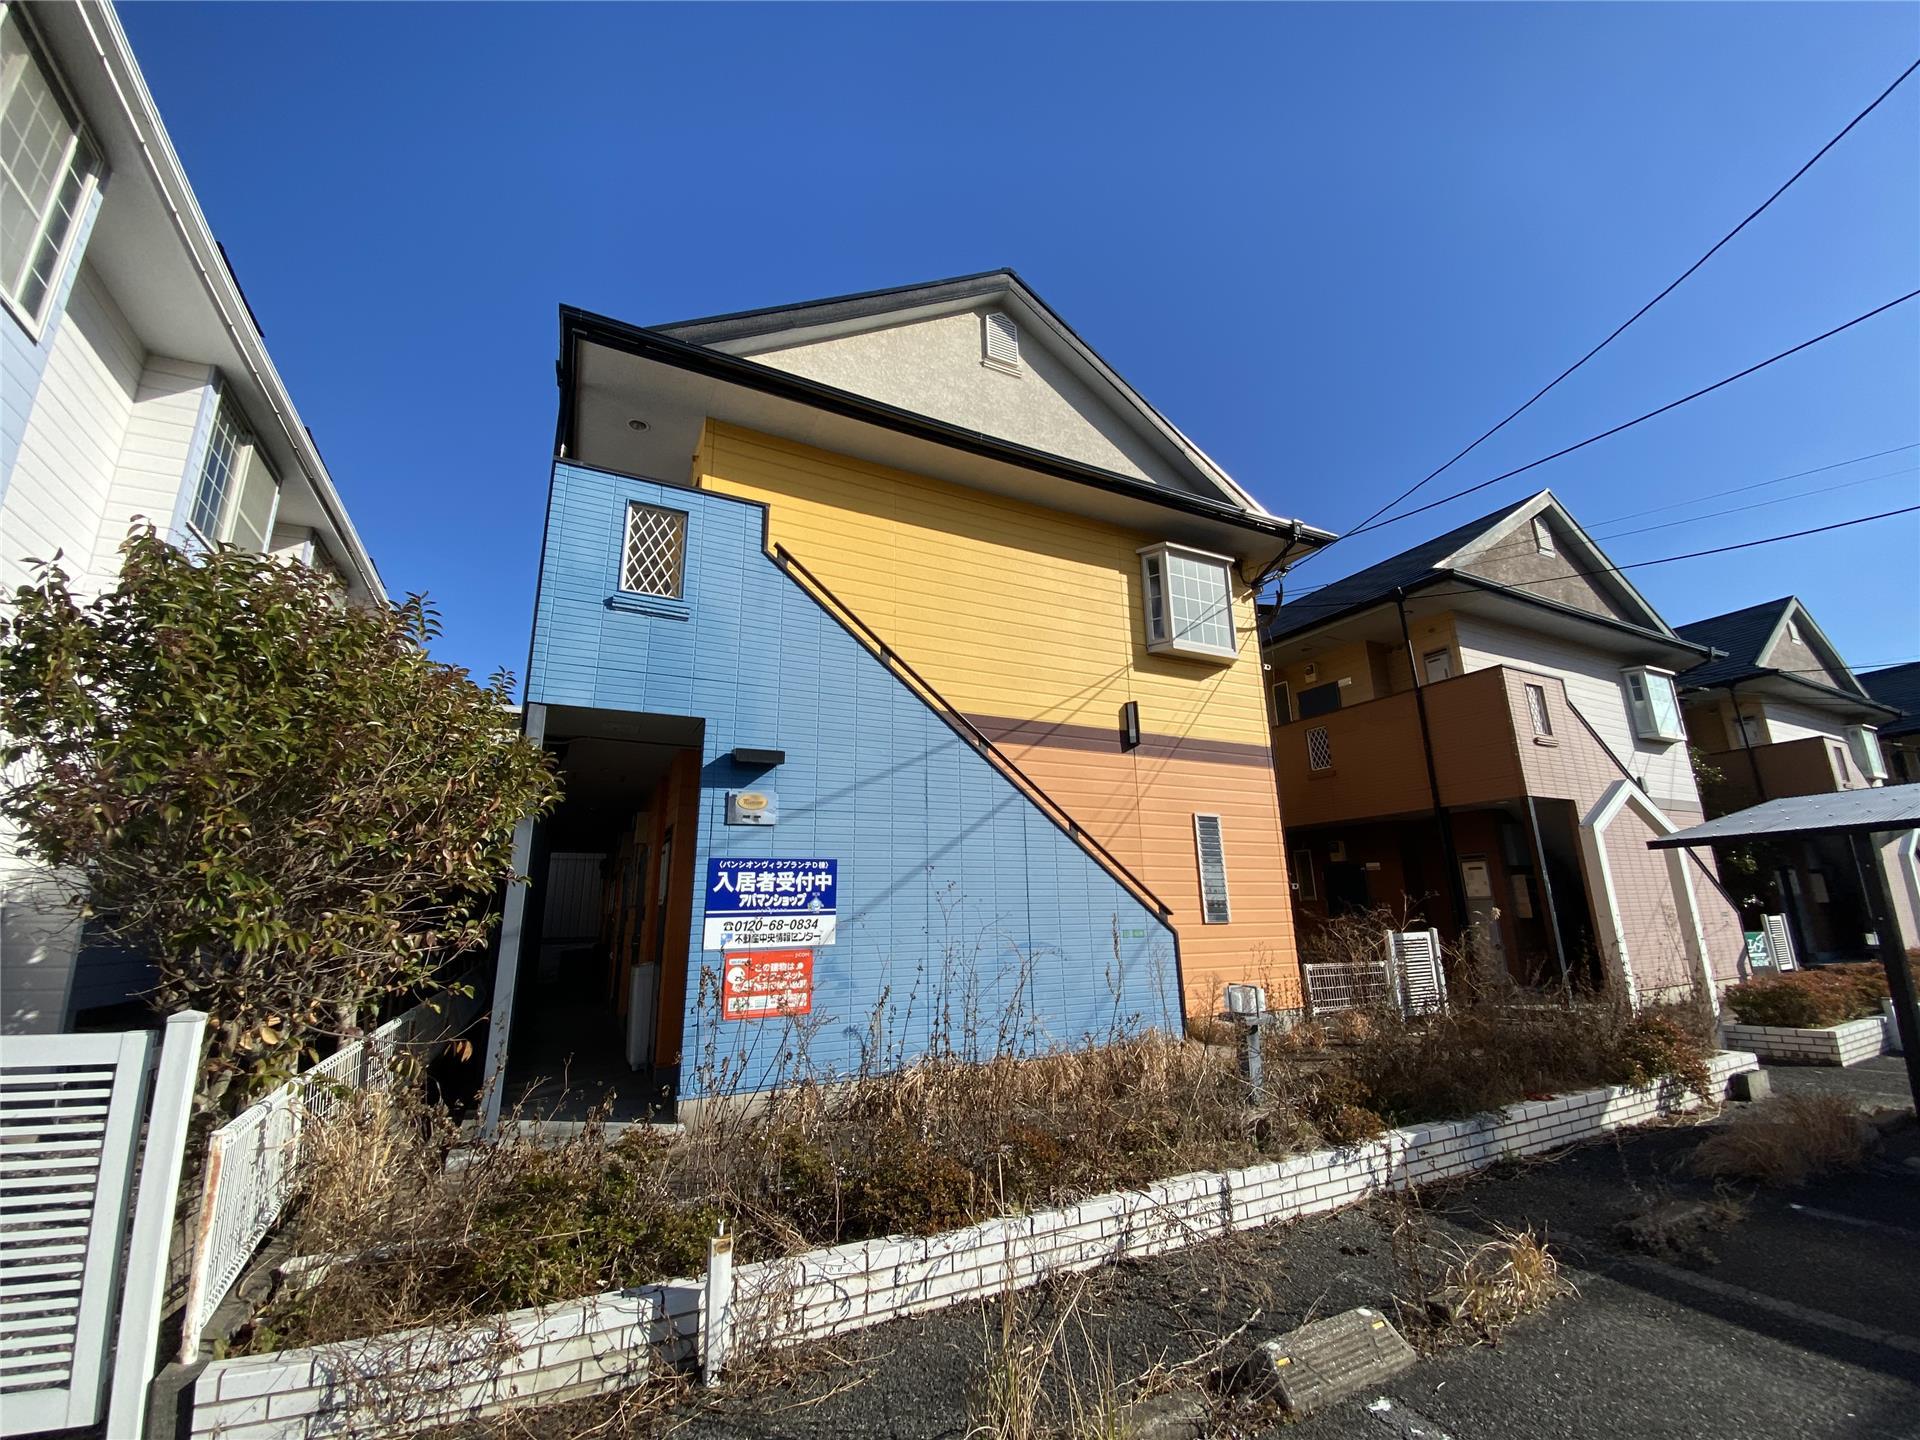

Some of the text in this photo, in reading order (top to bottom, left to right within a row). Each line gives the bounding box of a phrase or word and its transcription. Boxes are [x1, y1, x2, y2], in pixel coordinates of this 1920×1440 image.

[712, 871, 832, 893] 入居者受付中
[738, 893, 807, 908] アパマンショップ
[734, 918, 819, 932] 0120-68-0834
[734, 932, 821, 944] 不動産中央情報センター
